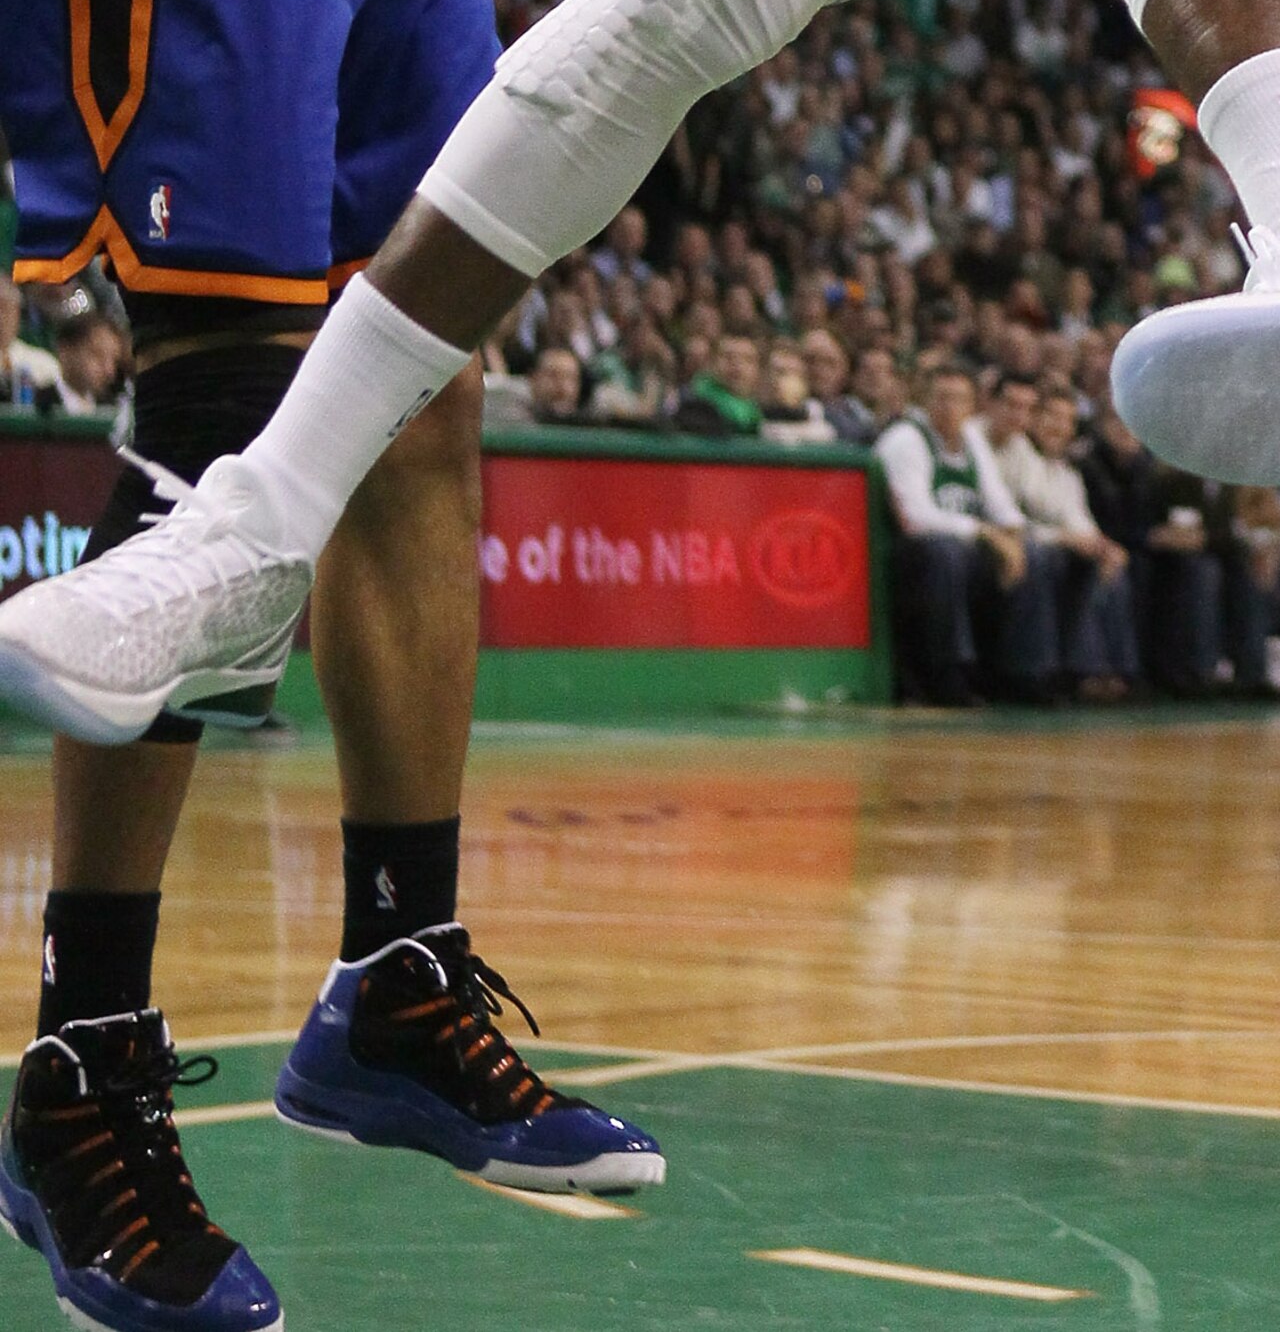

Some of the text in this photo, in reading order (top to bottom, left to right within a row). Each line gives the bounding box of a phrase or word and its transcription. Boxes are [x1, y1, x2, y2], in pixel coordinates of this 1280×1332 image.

[517, 523, 563, 586] of
[572, 526, 643, 586] the
[649, 528, 742, 586] NBA
